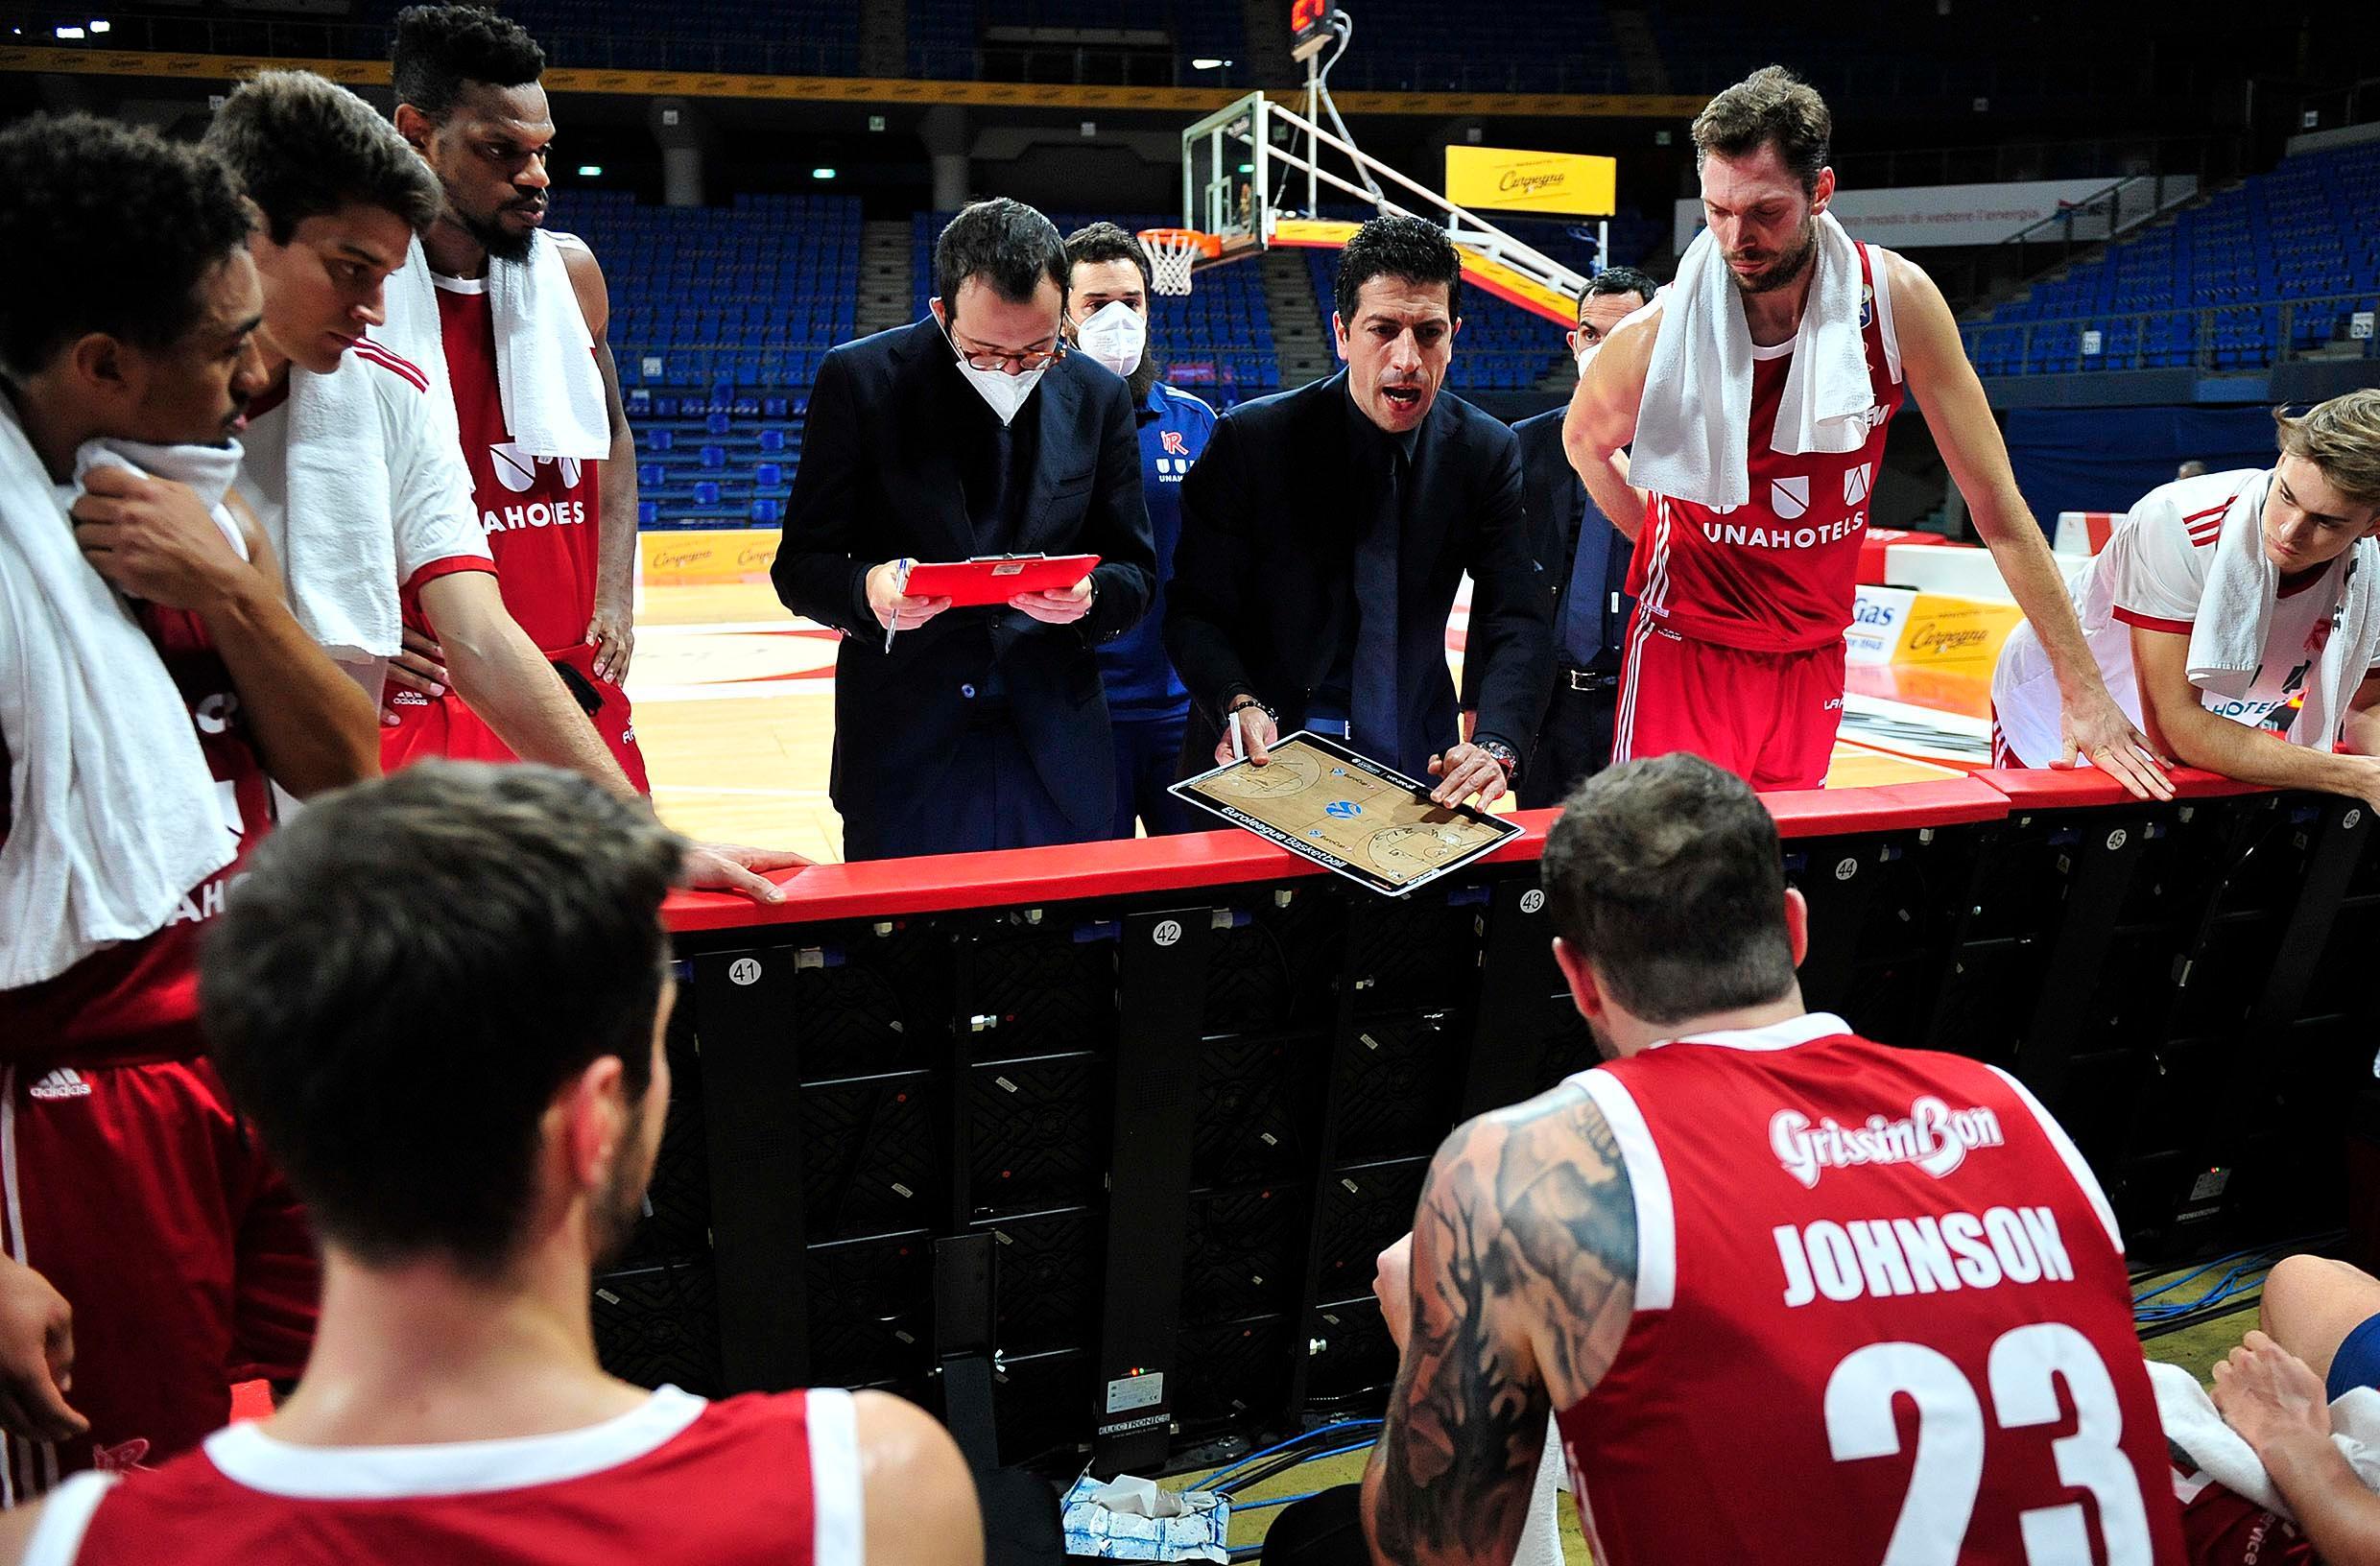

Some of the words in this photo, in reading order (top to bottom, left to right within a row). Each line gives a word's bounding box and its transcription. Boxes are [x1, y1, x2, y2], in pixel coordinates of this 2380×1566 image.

[1702, 510, 1865, 550] UNAHOTELS
[1221, 806, 1287, 841] Euroleague
[1283, 837, 1348, 868] Basketball
[1838, 861, 1855, 877] 44
[1522, 892, 1541, 910] 43
[1156, 924, 1178, 942] 42
[733, 961, 754, 981] 41
[30, 1081, 92, 1100] adidas
[1772, 1205, 2076, 1308] JOHNSON
[1823, 1321, 2154, 1566] 23
